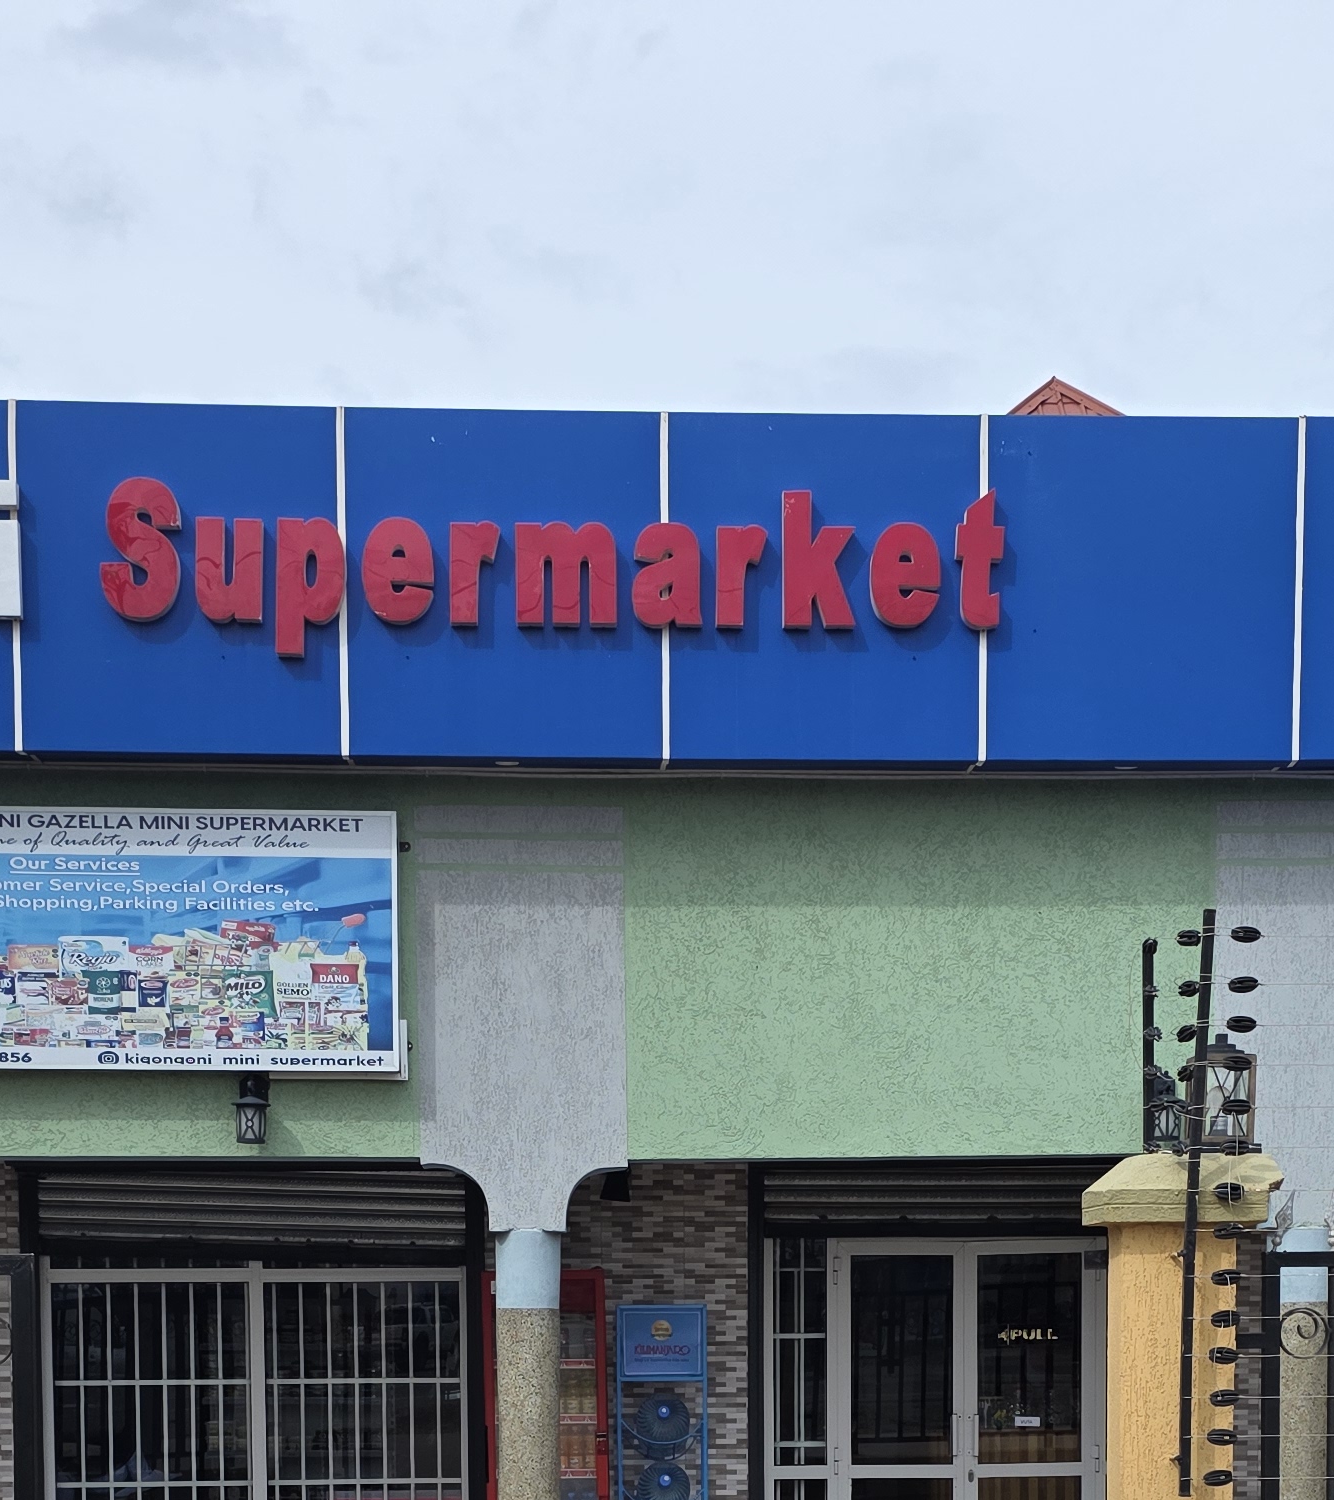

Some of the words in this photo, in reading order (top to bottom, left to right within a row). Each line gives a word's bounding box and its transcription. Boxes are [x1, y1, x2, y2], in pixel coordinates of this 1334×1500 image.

[99, 477, 1006, 658] Supermarket
[28, 814, 133, 829] GAZELLA
[139, 815, 190, 831] MINI
[196, 816, 364, 833] SUPERMARKET
[23, 832, 43, 853] of
[50, 832, 130, 856] Quality
[136, 834, 179, 848] and
[186, 833, 246, 854] Great
[252, 835, 310, 849] Value
[9, 856, 50, 871] Our
[54, 856, 141, 872] Services
[212, 880, 290, 897] Orders,
[184, 896, 276, 911] Facilities
[281, 898, 320, 912] etc.
[69, 952, 118, 968] Regio
[227, 980, 264, 992] MILO
[319, 974, 350, 983] DANO
[276, 988, 312, 997] SEMO
[223, 1054, 260, 1066] mini
[1010, 1328, 1059, 1340] PULL
